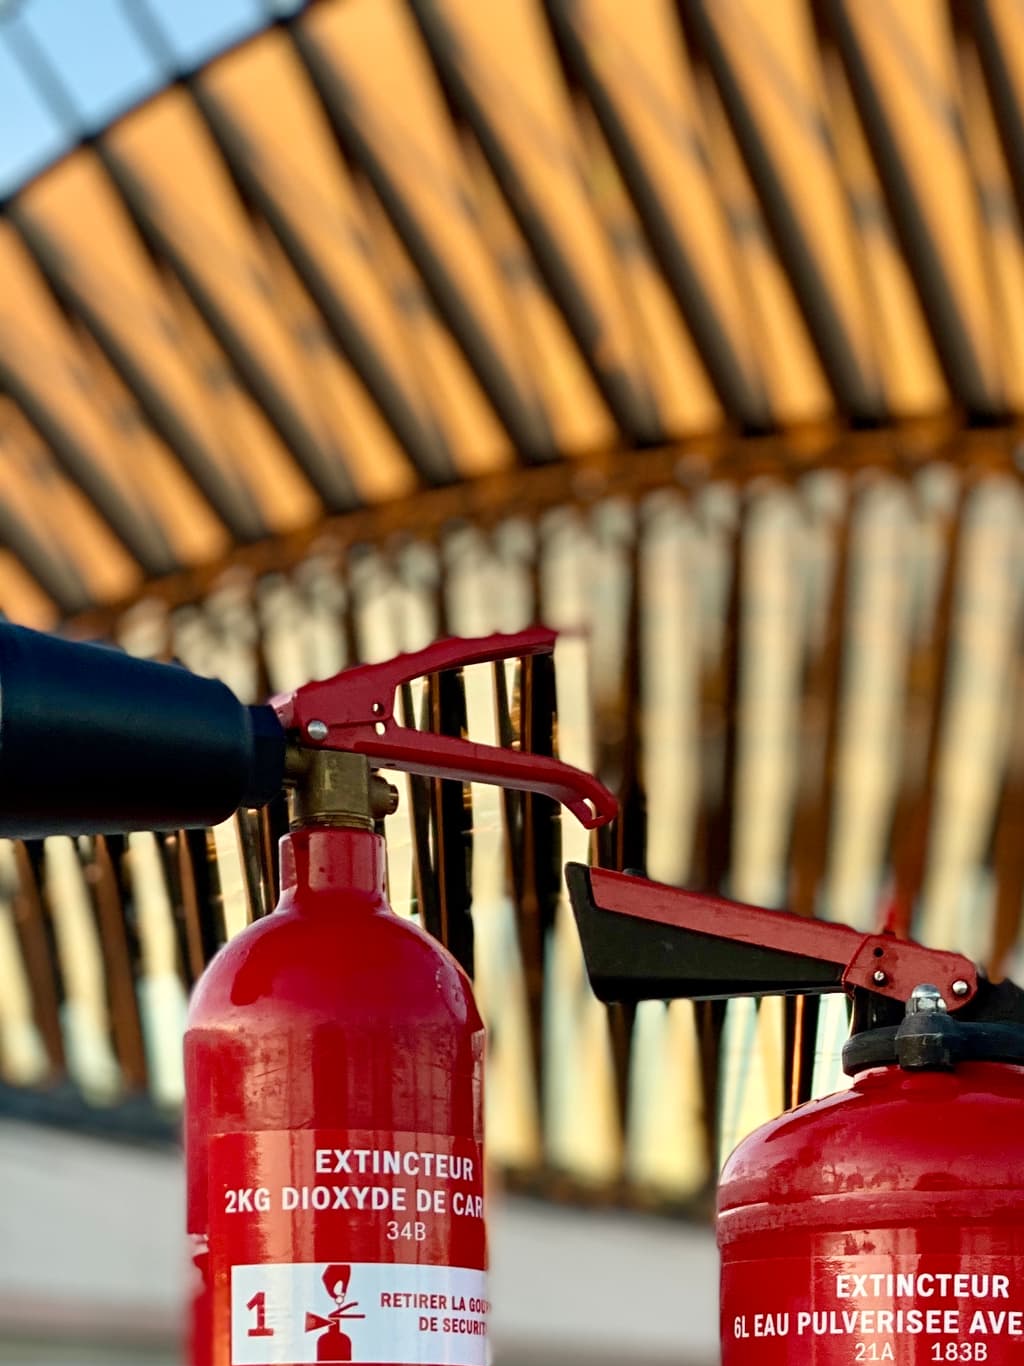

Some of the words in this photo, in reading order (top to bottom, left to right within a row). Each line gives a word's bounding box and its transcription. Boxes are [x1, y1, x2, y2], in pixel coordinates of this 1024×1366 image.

[315, 1149, 474, 1181] EXTINCTEUR
[224, 1188, 272, 1214] 2KG
[279, 1186, 407, 1212] DIOXYDE
[416, 1188, 446, 1214] DE
[386, 1220, 427, 1241] 34B
[833, 1272, 1010, 1299] EXTINCTEUR
[246, 1291, 274, 1337] 1
[380, 1292, 447, 1310] RETIRER
[451, 1295, 467, 1312] LA
[419, 1316, 438, 1332] DE
[734, 1315, 750, 1339] 6L
[754, 1312, 789, 1337] EAU
[797, 1309, 960, 1335] PULVERISEE
[855, 1341, 895, 1363] 21A
[931, 1342, 988, 1362] 183B
